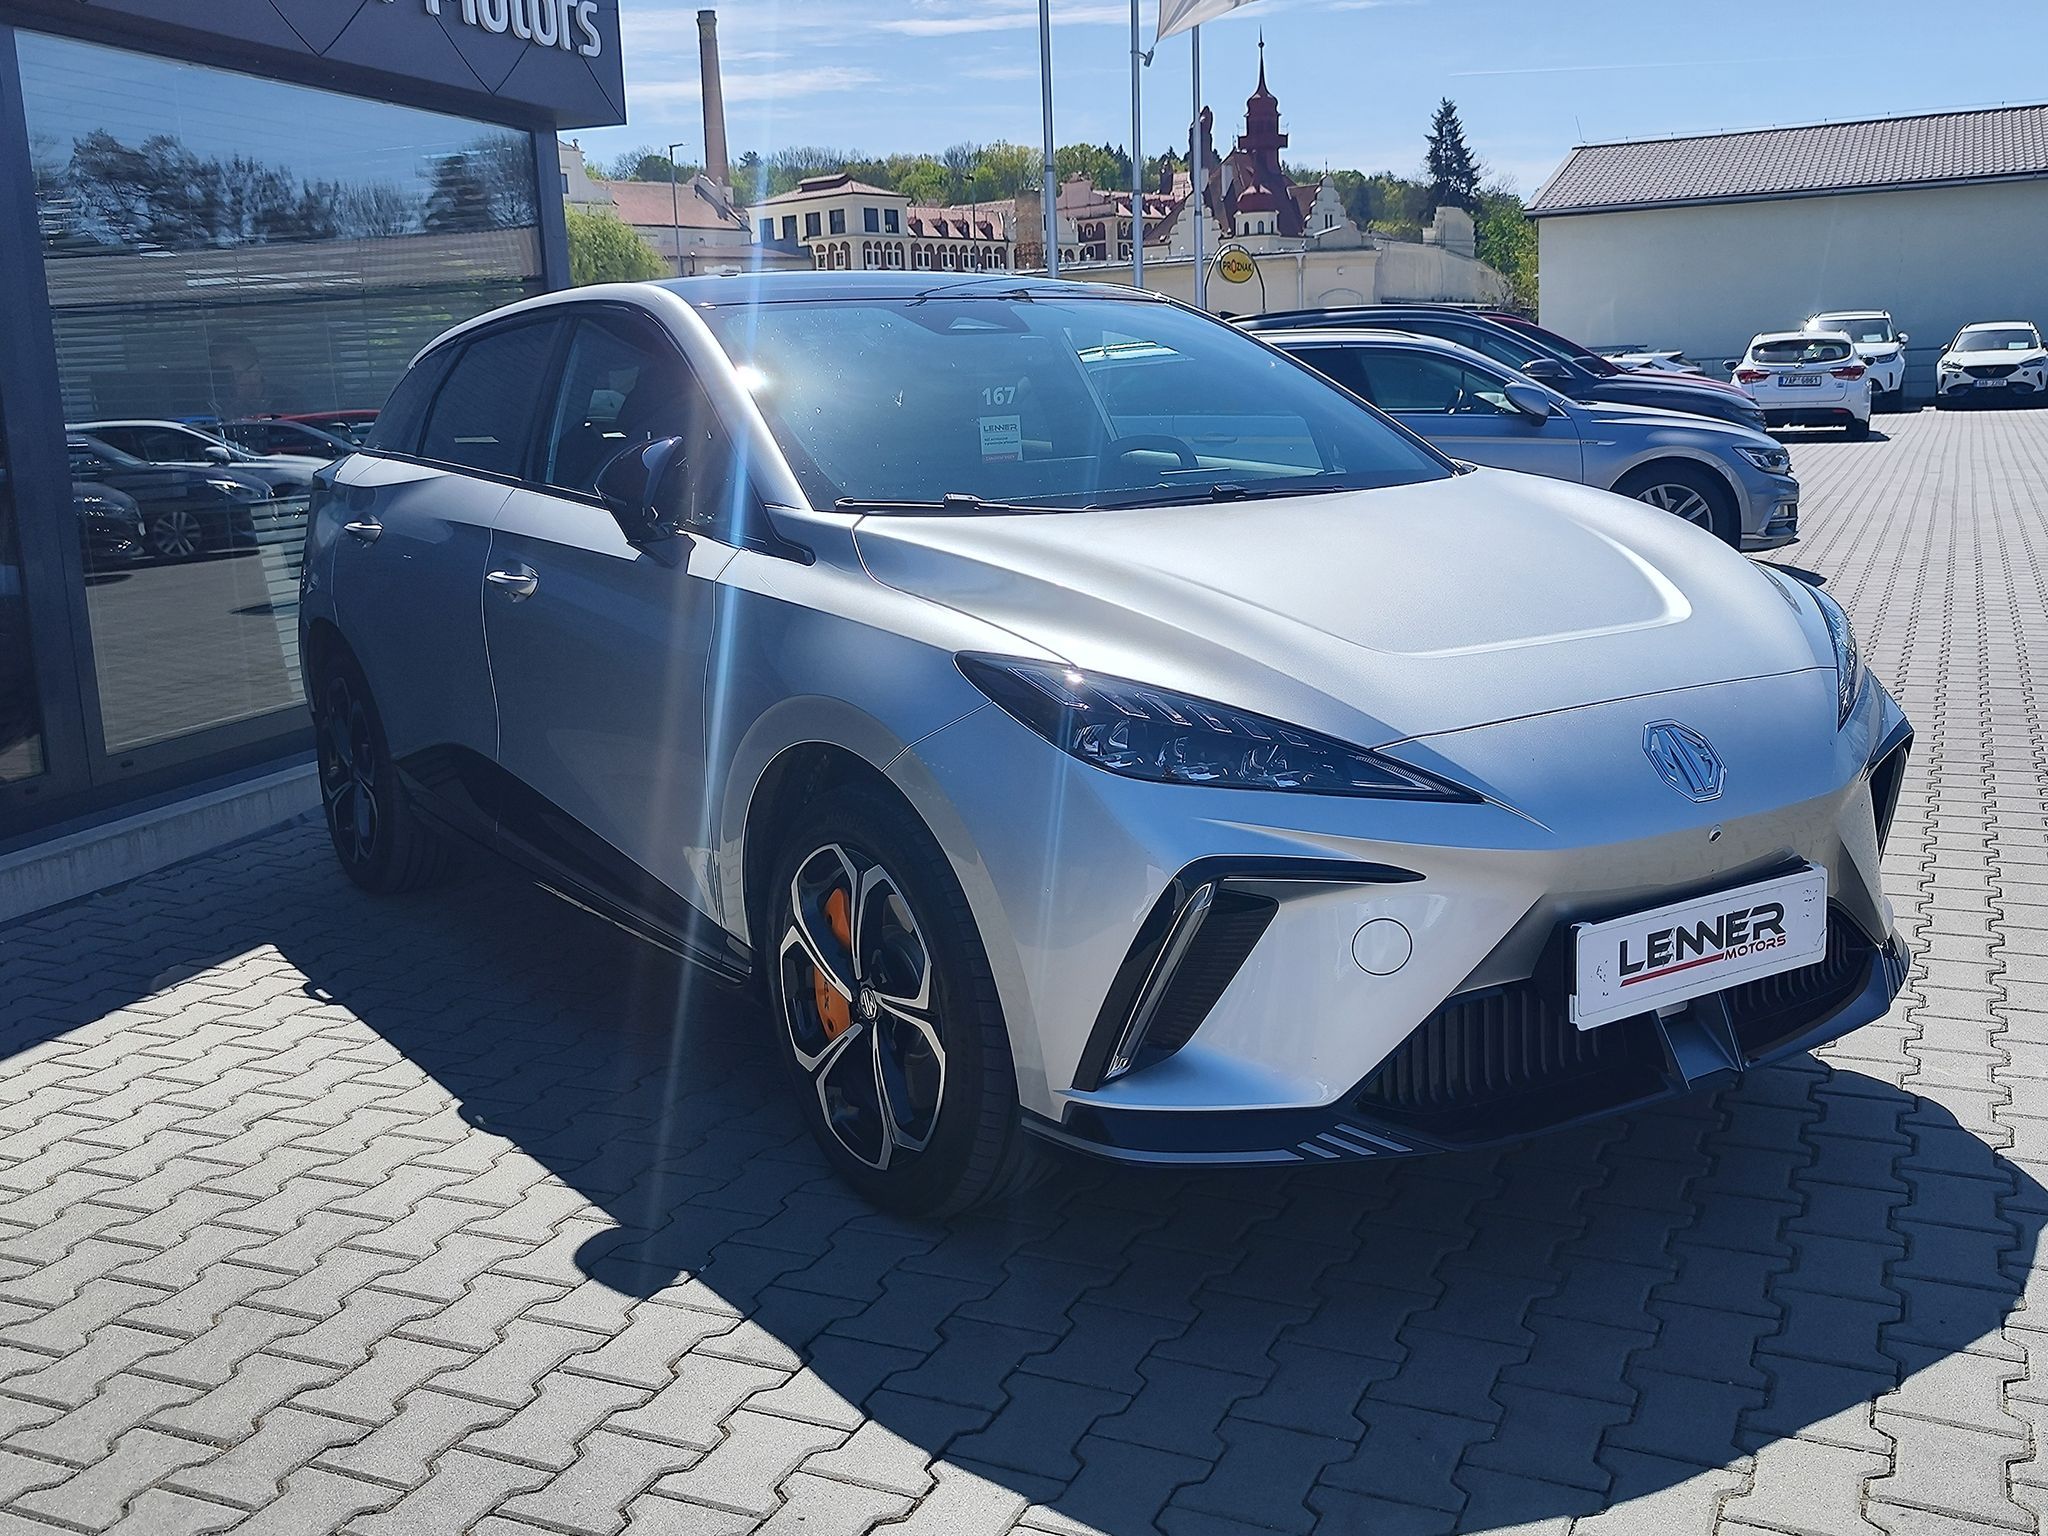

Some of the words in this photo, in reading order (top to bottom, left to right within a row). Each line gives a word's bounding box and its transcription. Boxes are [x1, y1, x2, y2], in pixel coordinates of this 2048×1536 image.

[982, 387, 1016, 405] 167
[983, 423, 1018, 431] LENNER
[1648, 724, 1719, 797] MG
[1619, 901, 1787, 977] LENNER
[1724, 935, 1787, 961] MOTORS
